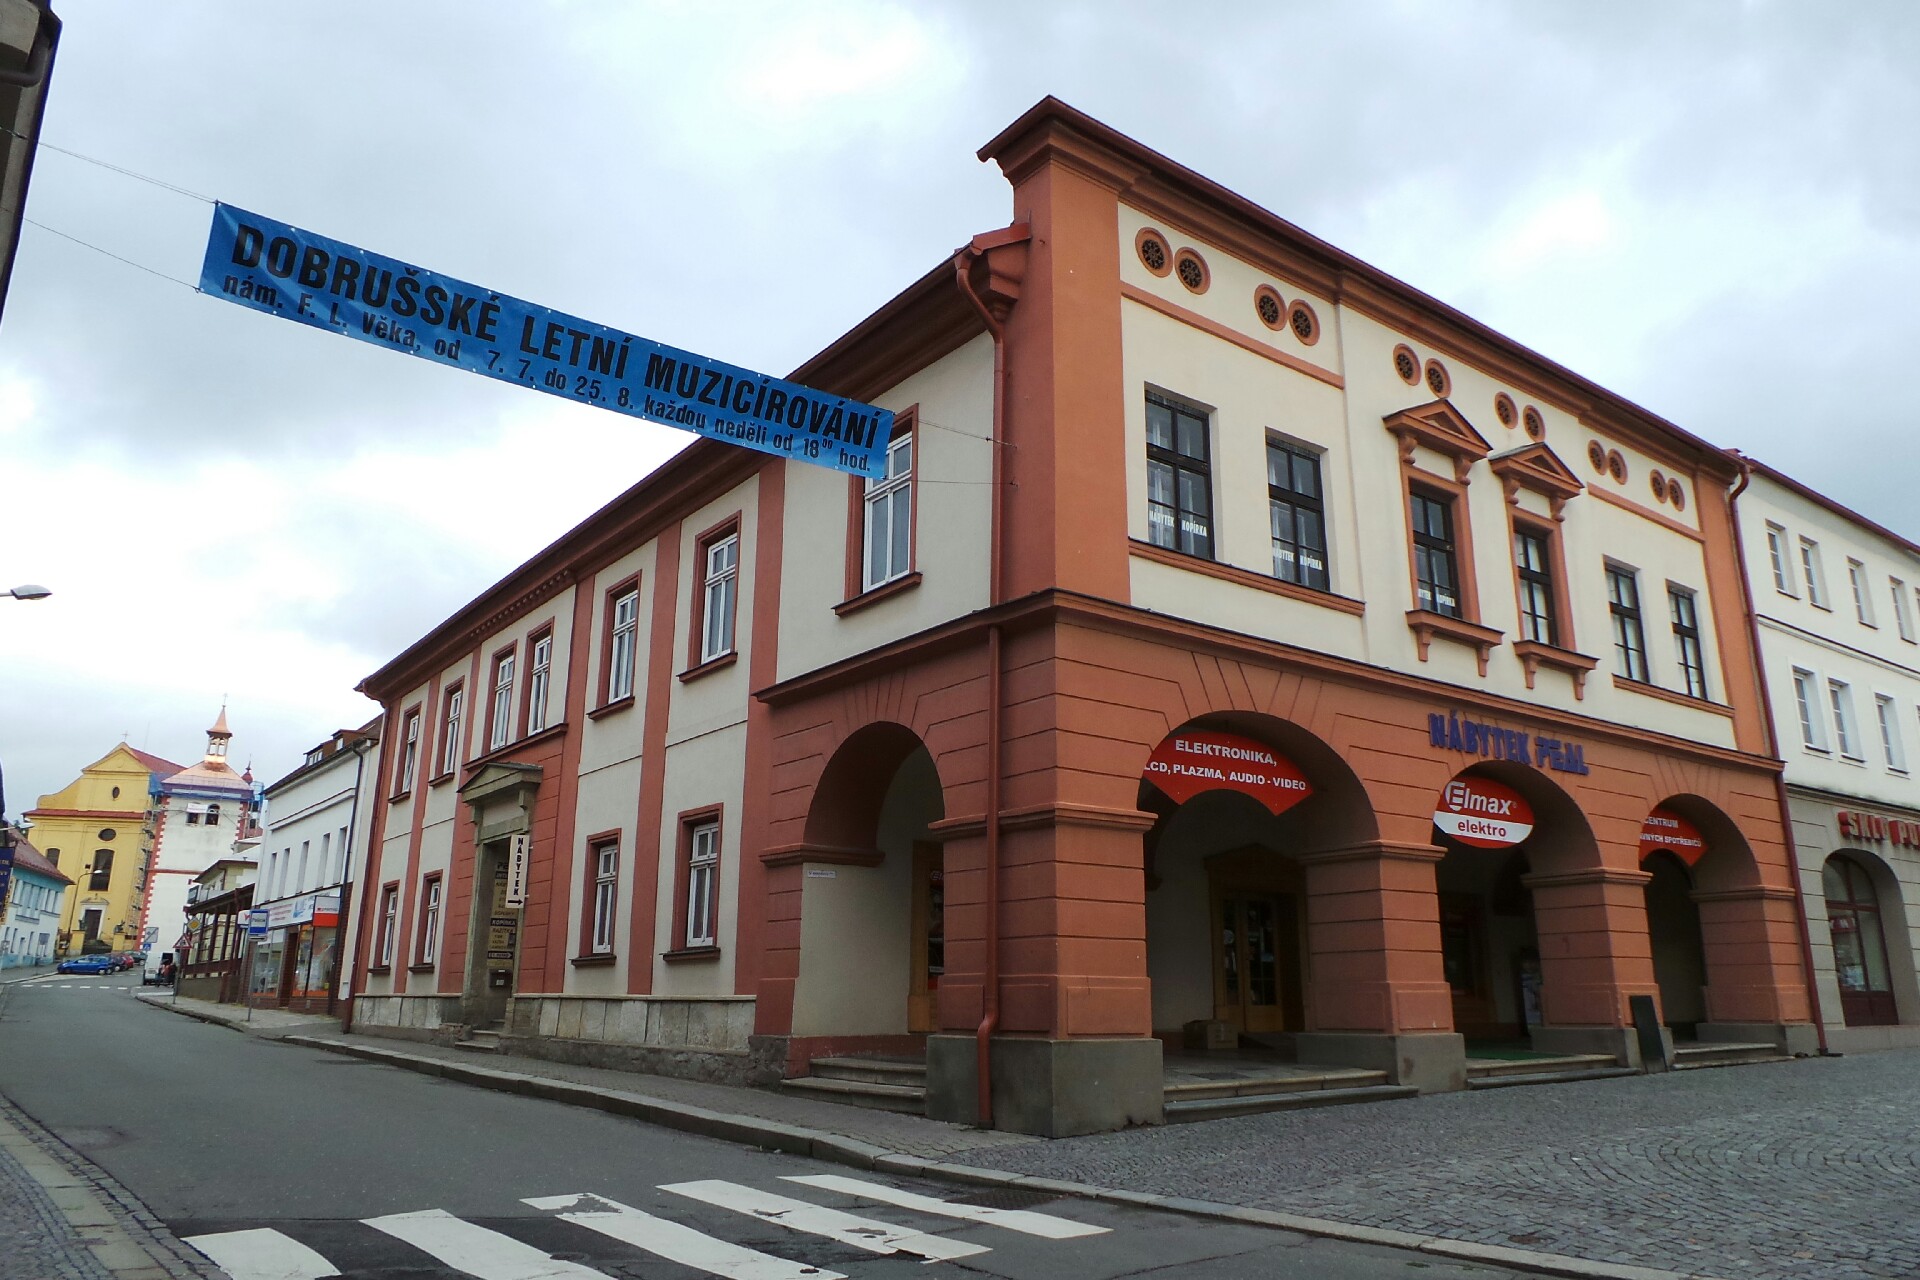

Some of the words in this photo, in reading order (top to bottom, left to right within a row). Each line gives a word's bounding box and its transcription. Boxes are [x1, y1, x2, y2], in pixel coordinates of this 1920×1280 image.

[232, 223, 502, 342] DOBRUŠSKÉ
[520, 314, 632, 379] LETNÍ
[644, 354, 883, 449] MUZICÍROVÁNÍ
[223, 273, 283, 308] nám.
[298, 297, 315, 318] F.
[329, 302, 347, 328] L.
[434, 337, 460, 361] od
[488, 350, 504, 373] 7.
[518, 359, 534, 381] 7.
[545, 368, 566, 390] do
[574, 376, 605, 402] 25.
[617, 387, 633, 409] 8.
[644, 395, 706, 429] každou
[714, 417, 766, 446] neděli
[773, 431, 793, 451] od
[839, 447, 870, 472] hod.
[1175, 739, 1277, 767] ELEKTRONIKA,
[1428, 709, 1532, 766] NÁBYTEK
[1173, 763, 1226, 781] PLAZMA,
[1229, 771, 1265, 785] AUDIO
[1273, 777, 1306, 791] VIDEO
[1445, 780, 1511, 816] Elmax
[1457, 819, 1507, 838] elektro
[513, 837, 523, 896] NÁBYTEK
